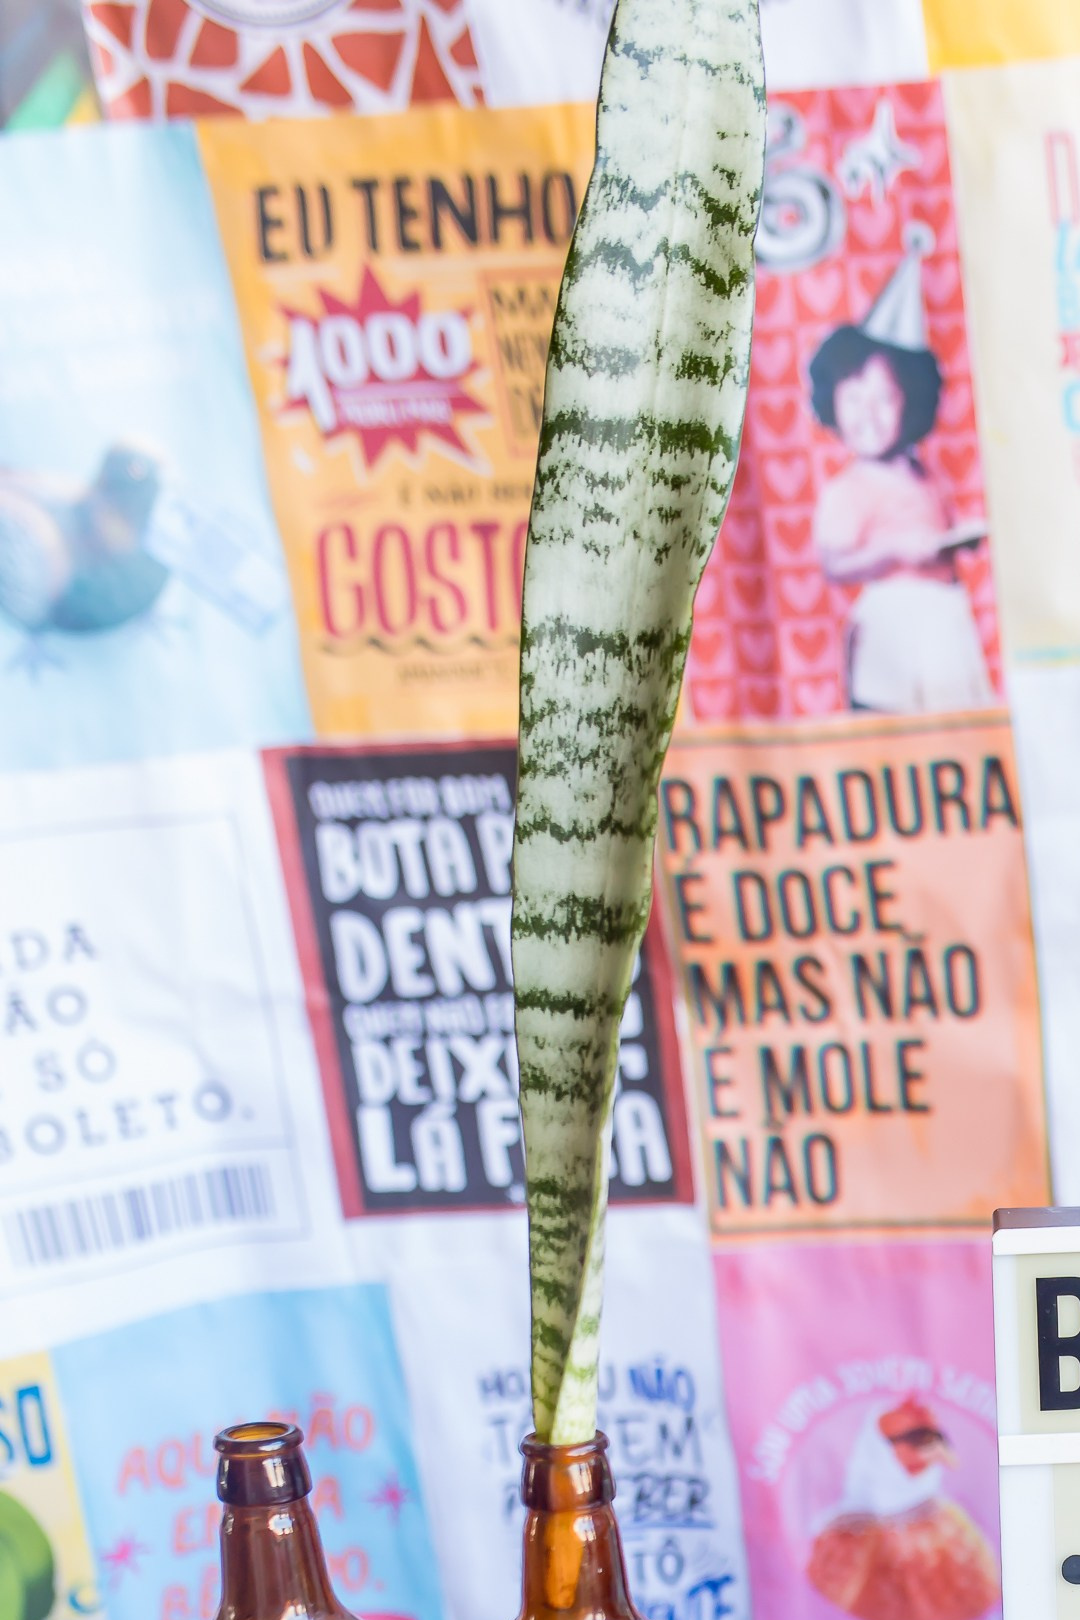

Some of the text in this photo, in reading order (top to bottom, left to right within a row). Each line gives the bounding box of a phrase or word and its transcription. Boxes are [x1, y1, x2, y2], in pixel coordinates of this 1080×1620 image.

[254, 170, 575, 262] EU TENHO
[286, 308, 473, 432] 1000
[660, 755, 1022, 852] RAPADURA
[315, 815, 478, 903] BOTA
[732, 859, 901, 943] DOCE
[0, 924, 98, 972] DA
[686, 930, 982, 1030] MAS NÃO
[758, 1039, 932, 1116] MOLE
[356, 1098, 468, 1193] LÁ
[713, 1115, 839, 1210] NÃO
